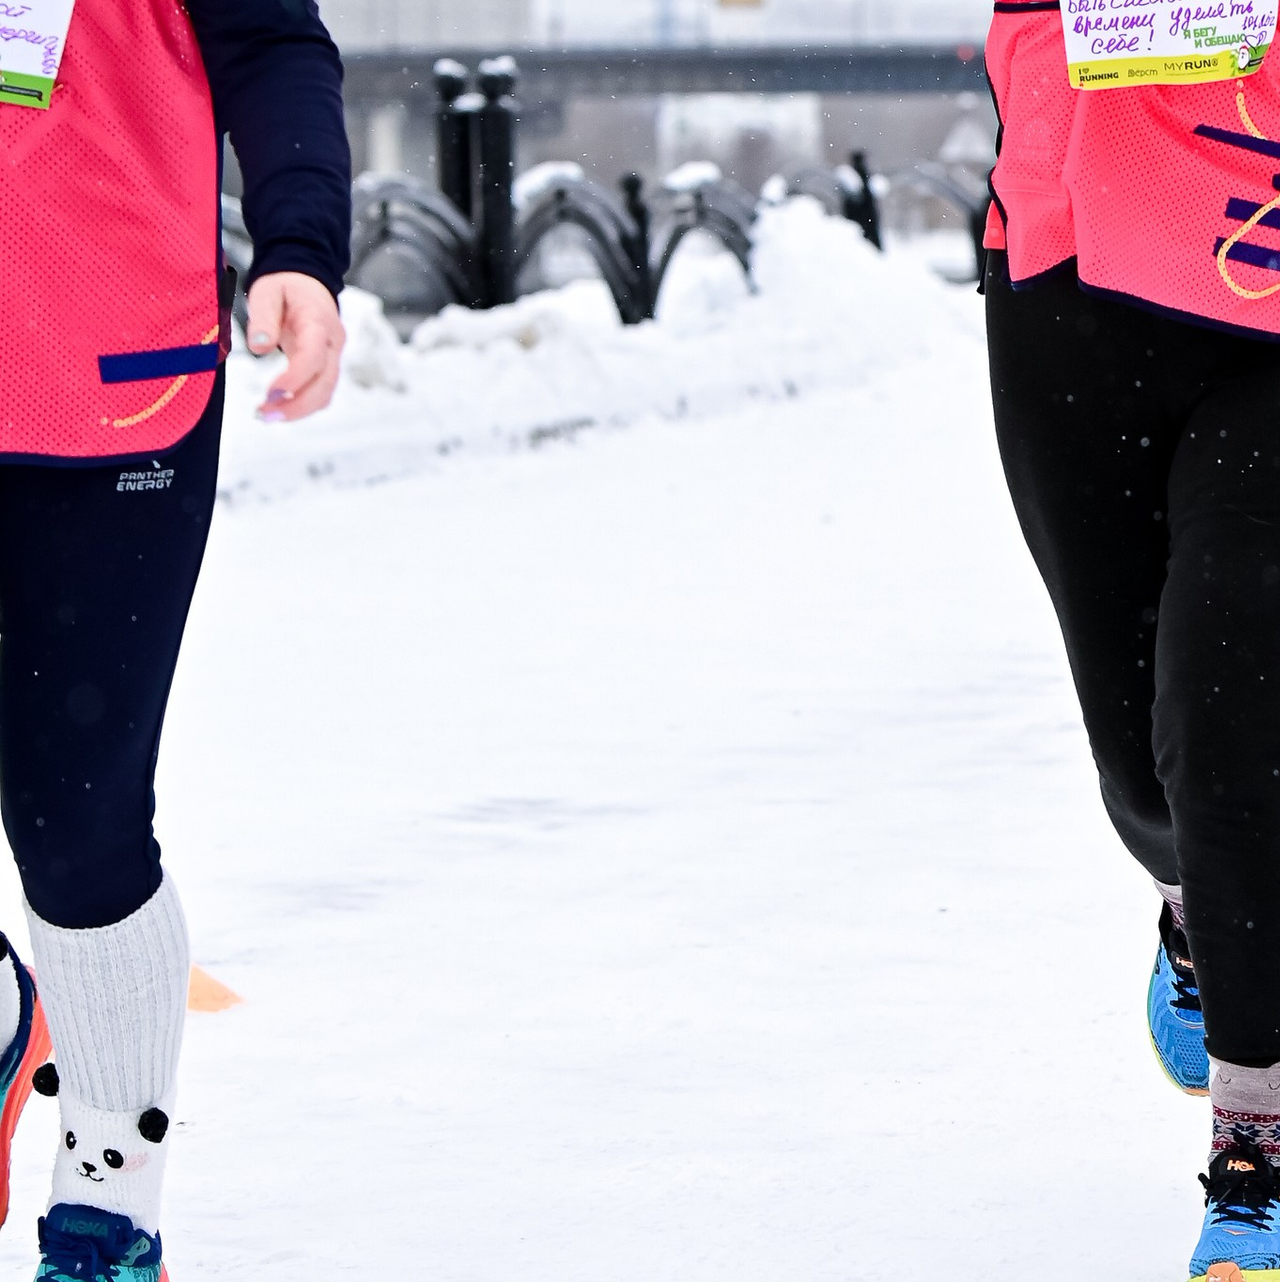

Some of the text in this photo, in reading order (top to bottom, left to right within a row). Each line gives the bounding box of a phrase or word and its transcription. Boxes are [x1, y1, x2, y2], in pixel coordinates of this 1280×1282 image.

[1073, 13, 1156, 37] времени
[1183, 26, 1217, 39] Я БЕГУ
[1194, 33, 1246, 48] И ОБЕЩАЮ
[1080, 72, 1119, 82] RUNNING
[119, 469, 175, 481] PANTHER
[116, 478, 173, 492] ENERGY
[61, 1217, 109, 1237] HOKA
